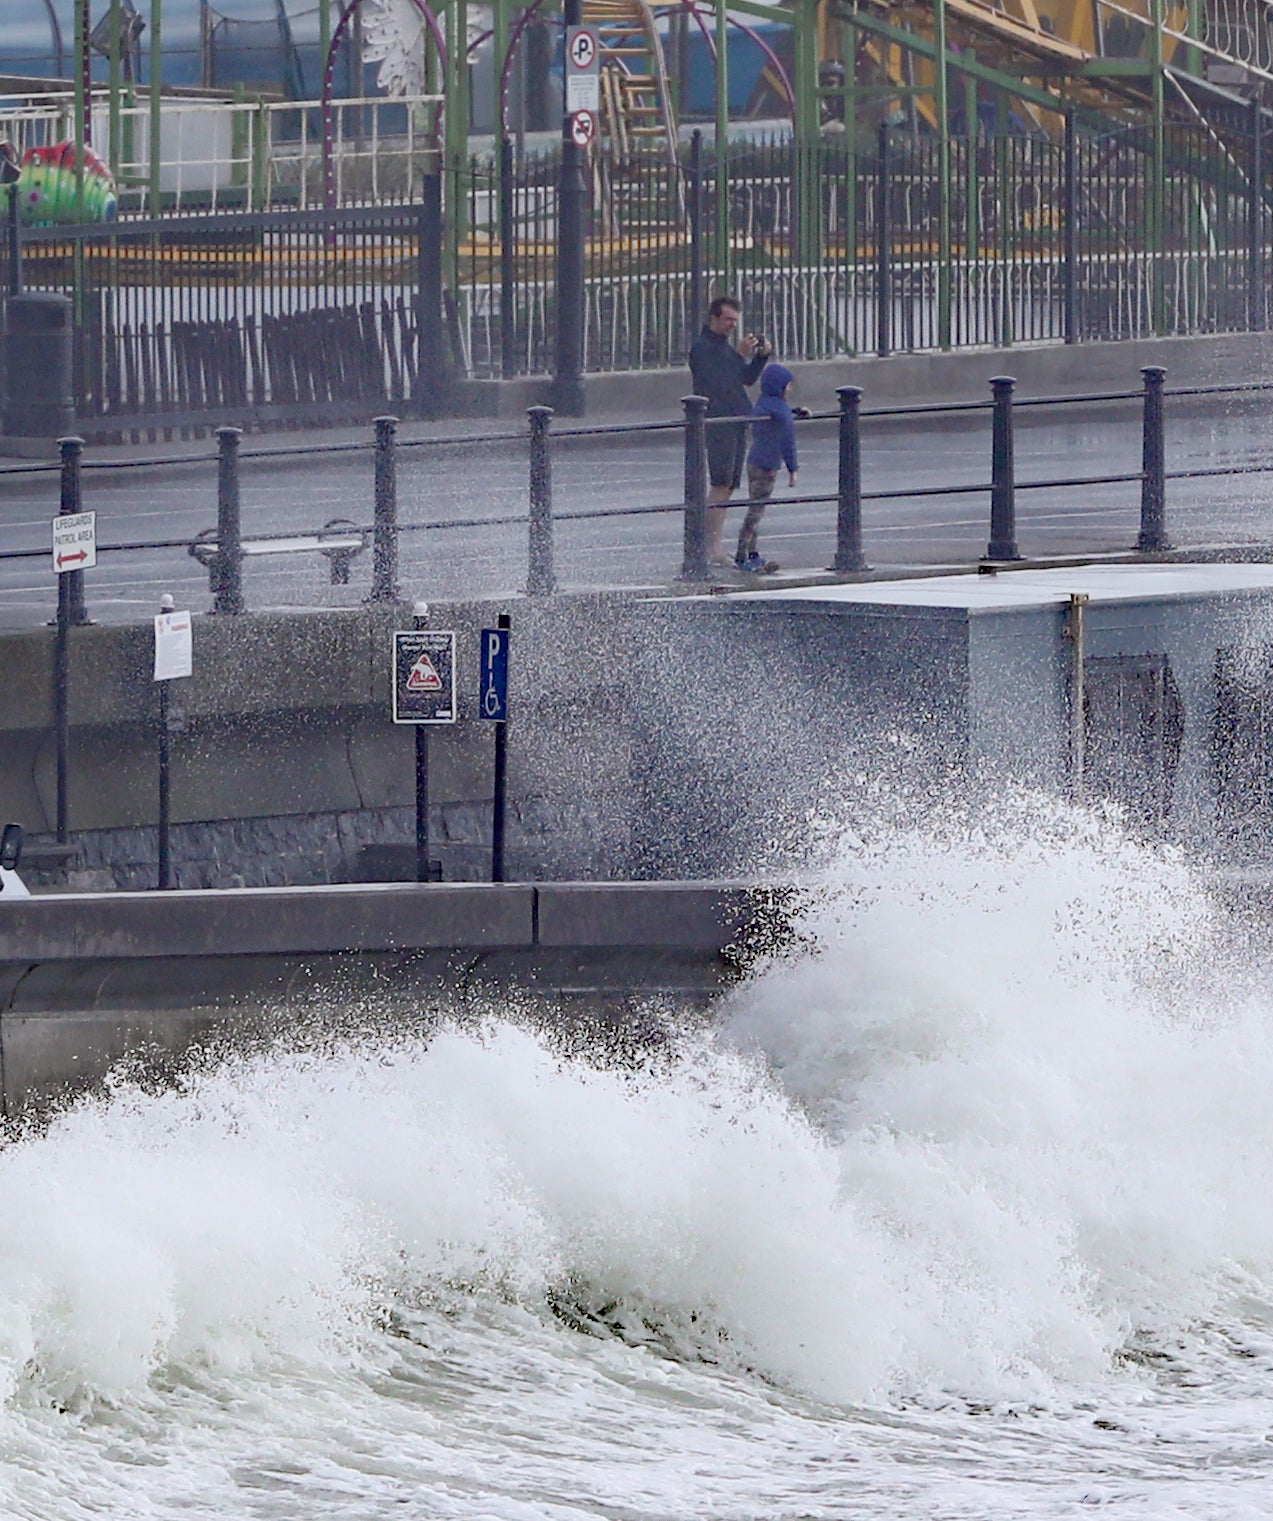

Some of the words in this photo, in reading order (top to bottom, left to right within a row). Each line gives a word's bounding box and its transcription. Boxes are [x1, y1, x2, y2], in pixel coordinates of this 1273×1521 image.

[579, 39, 588, 59] P
[55, 514, 93, 530] LIFEGUARDS
[55, 533, 77, 545] PATROL
[78, 530, 93, 541] AREA
[488, 633, 500, 670] P
